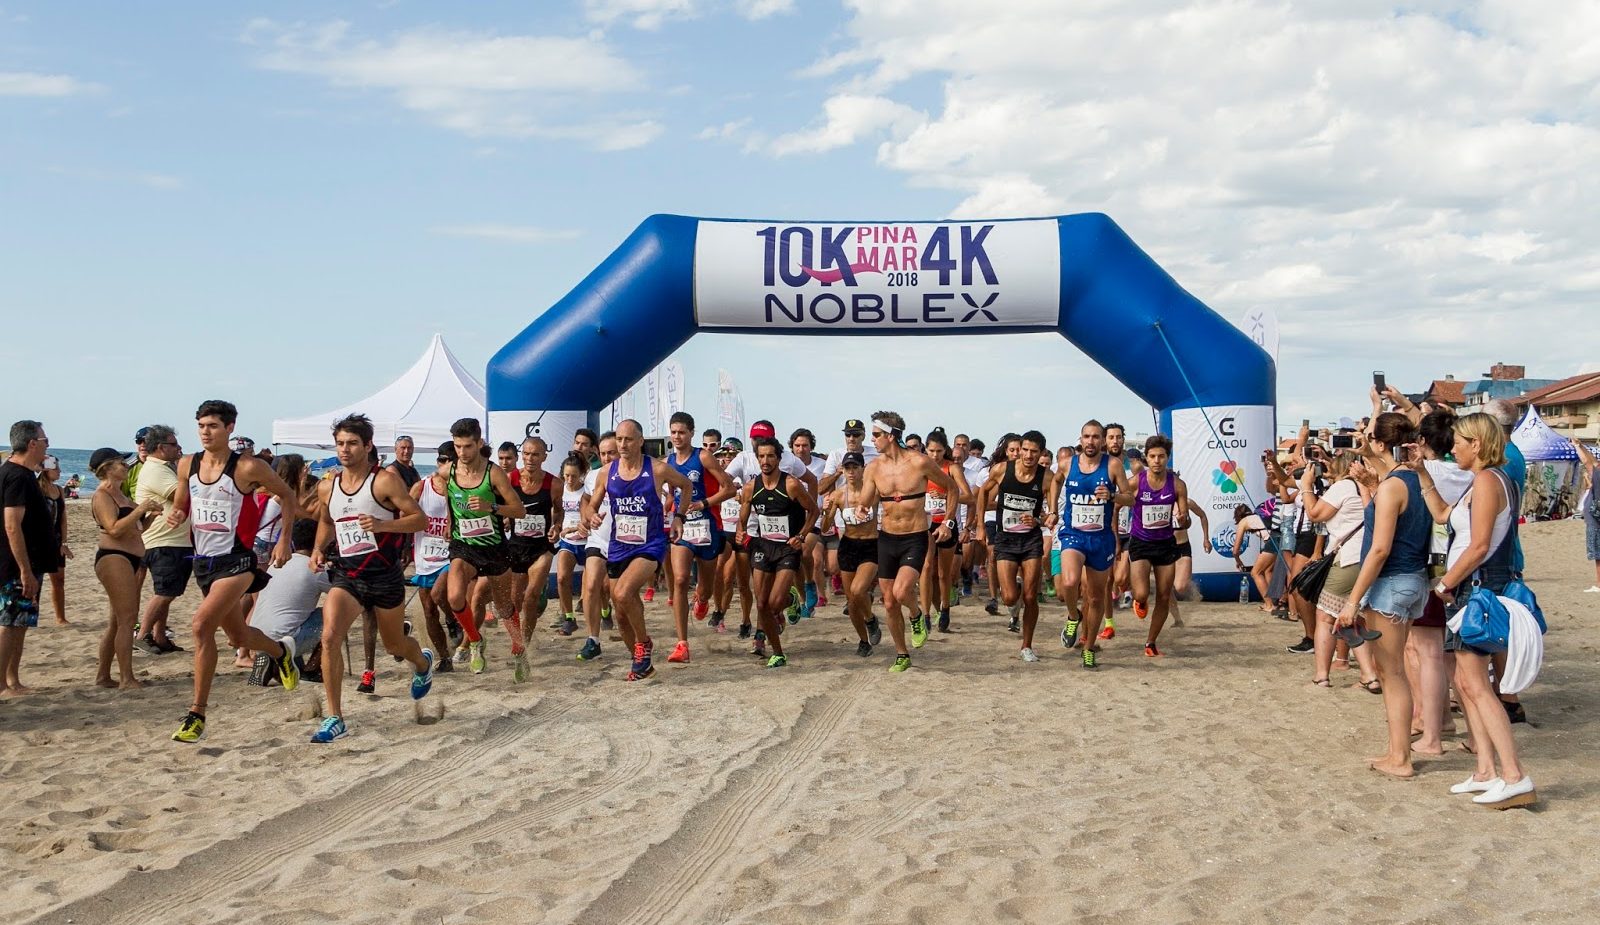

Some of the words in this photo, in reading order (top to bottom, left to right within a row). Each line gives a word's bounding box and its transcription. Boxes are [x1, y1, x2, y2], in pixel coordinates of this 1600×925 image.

[857, 226, 918, 243] PINA
[756, 226, 858, 287] 10K
[857, 246, 918, 271] MAR
[920, 225, 999, 286] 4K
[887, 272, 918, 287] 2018
[764, 292, 1000, 324] NOBLEX
[1207, 439, 1247, 449] CALOU
[615, 496, 647, 505] BOLSA
[618, 503, 645, 513] PACK
[197, 508, 226, 523] 1163
[1076, 513, 1101, 524] 1257
[1145, 511, 1169, 522] 1198
[461, 518, 490, 530] 4112
[618, 523, 643, 536] 4041
[762, 523, 787, 533] 1234
[340, 530, 371, 545] 1164
